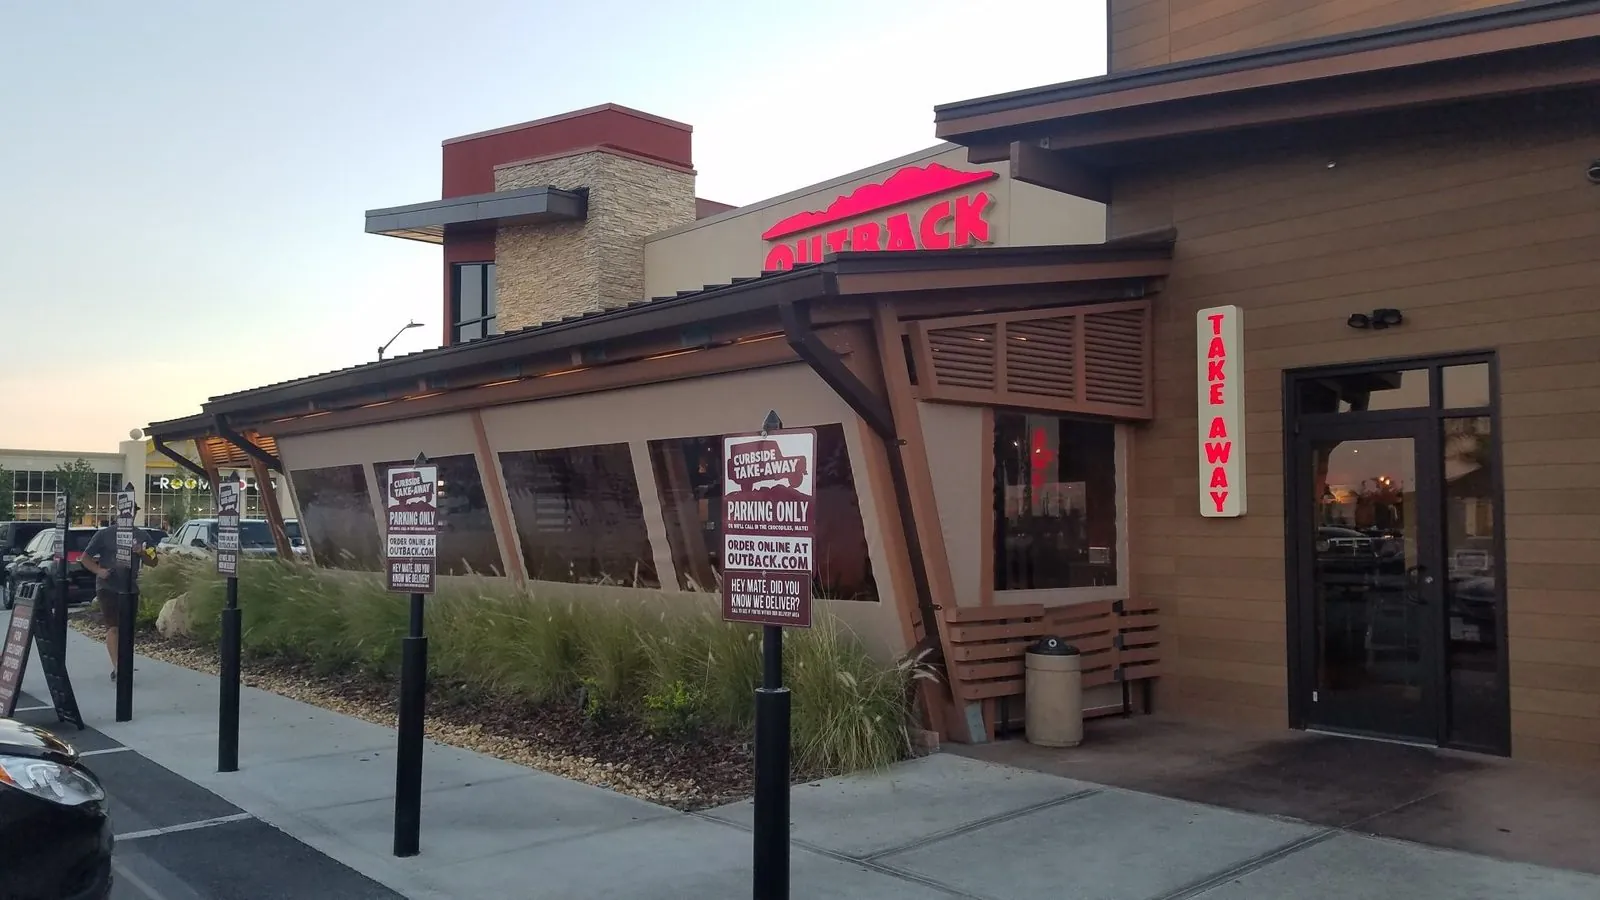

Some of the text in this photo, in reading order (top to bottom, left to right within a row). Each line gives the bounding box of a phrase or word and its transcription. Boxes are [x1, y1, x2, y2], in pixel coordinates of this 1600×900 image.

[1204, 313, 1232, 512] TAKE AWAY
[734, 449, 776, 466] CURBSIDE
[734, 459, 798, 479] TAKE-AWAY
[160, 477, 211, 490] ROOM
[389, 511, 436, 525] PARKING ONLY
[728, 501, 809, 522] PARKING ONLY
[389, 538, 435, 546] ORDER ONLINE AT
[728, 540, 809, 554] ORDER ONLINE AT
[389, 547, 434, 556] OUTBACK.COM
[728, 553, 808, 570] OUTBACK.COM
[731, 578, 800, 595] HEY MATE, DID YOU
[731, 593, 800, 611] KNOW WE DELIVER?
